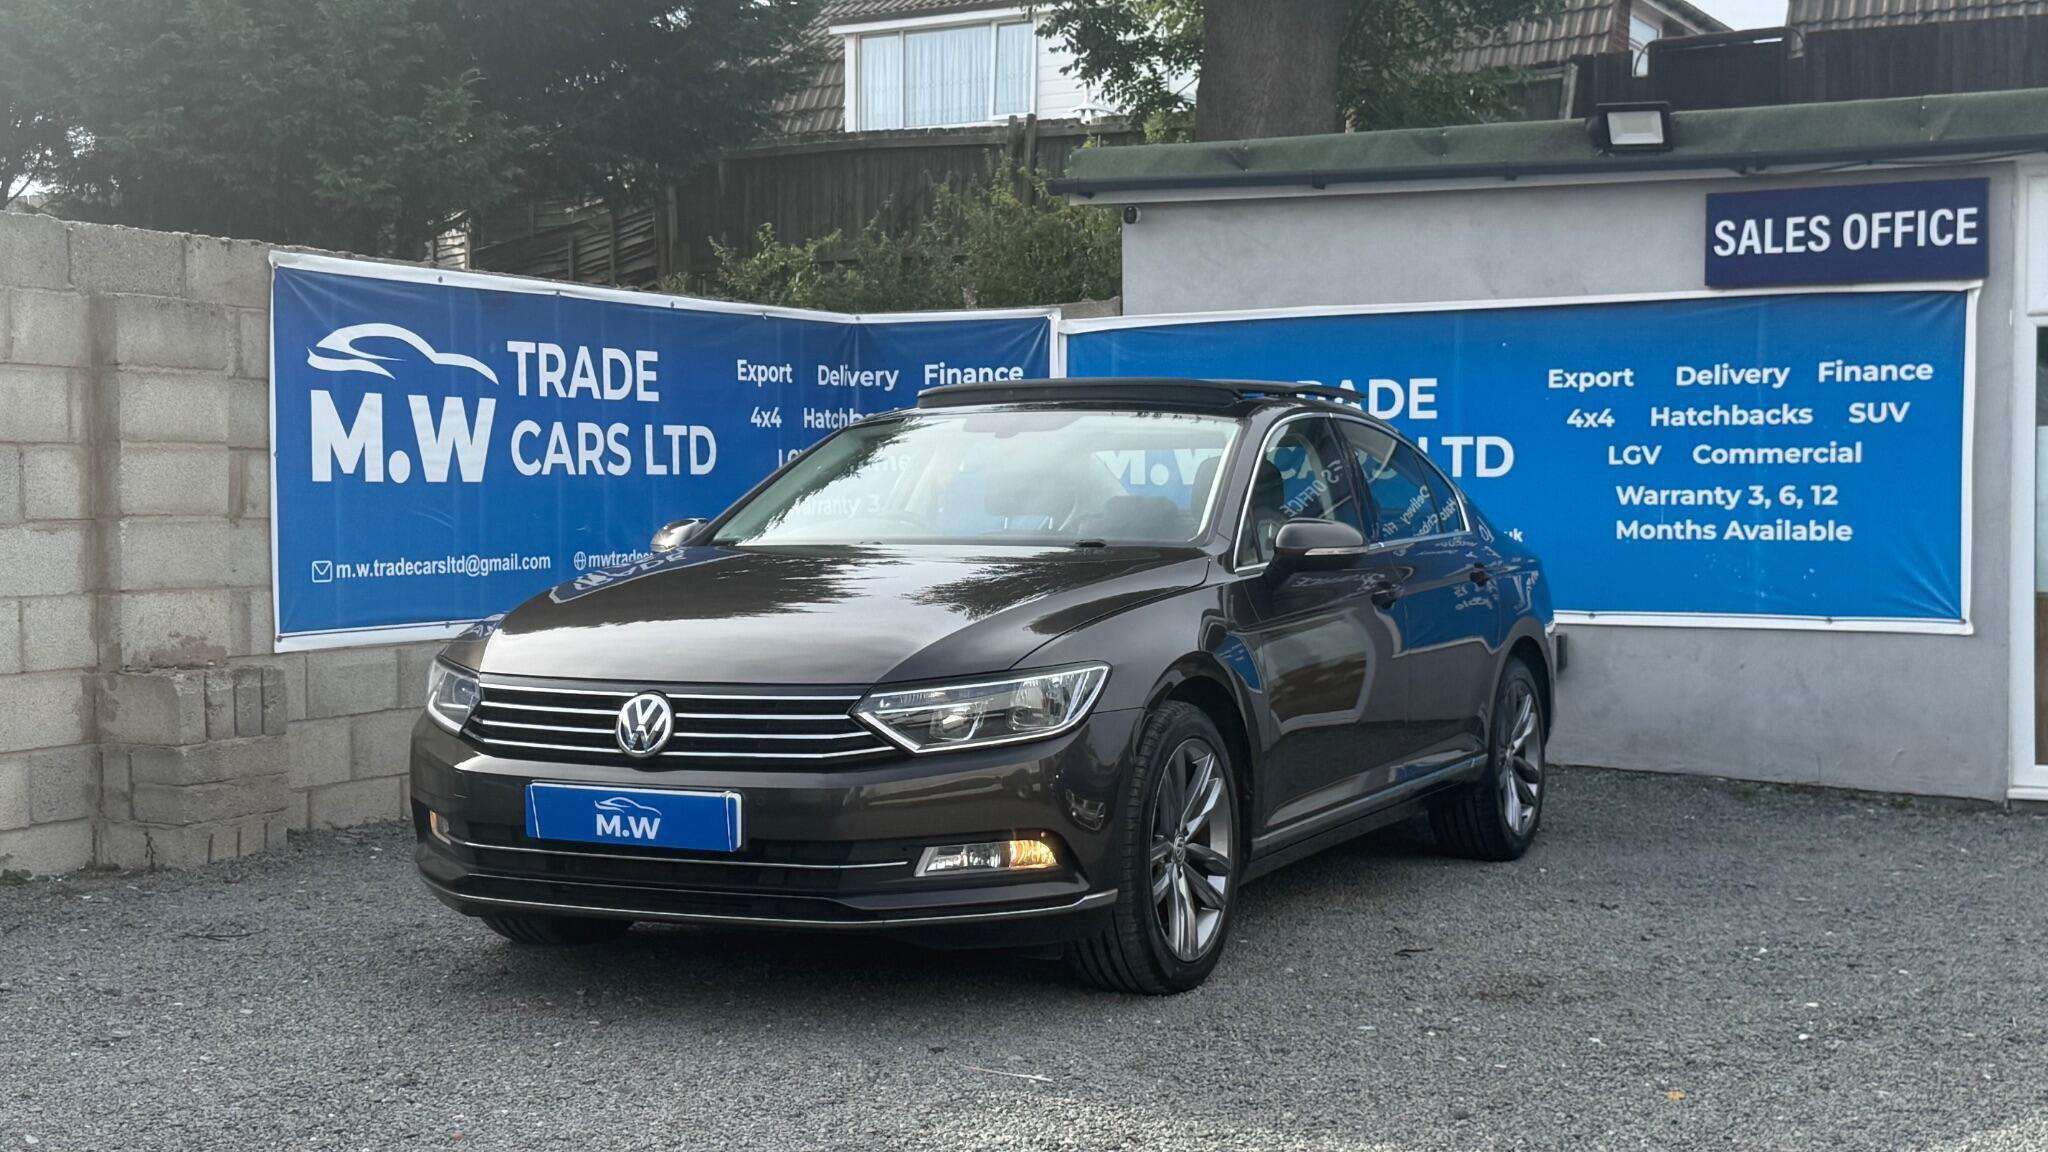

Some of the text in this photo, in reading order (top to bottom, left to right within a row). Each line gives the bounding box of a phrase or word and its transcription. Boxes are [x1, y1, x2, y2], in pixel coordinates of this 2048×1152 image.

[1712, 207, 1979, 257] SALES OFFICE
[507, 341, 659, 402] TRADE
[737, 359, 1024, 391] Export Delivery Finance
[1547, 360, 1934, 393] Export Delivery Finance
[750, 406, 783, 428] 4x4
[1566, 402, 1910, 428] 4x4 Hatchbacks SUV
[310, 389, 497, 483] M.W
[510, 420, 631, 477] CARS
[644, 422, 718, 476] LTD
[1607, 441, 1862, 466] LGV Commercial
[1615, 484, 1839, 510] Warranty 3, 6, 12
[1616, 519, 1853, 542] Months Available
[336, 552, 551, 578] m.w.tradecarsltd@gmail.com
[596, 813, 661, 841] M.W
